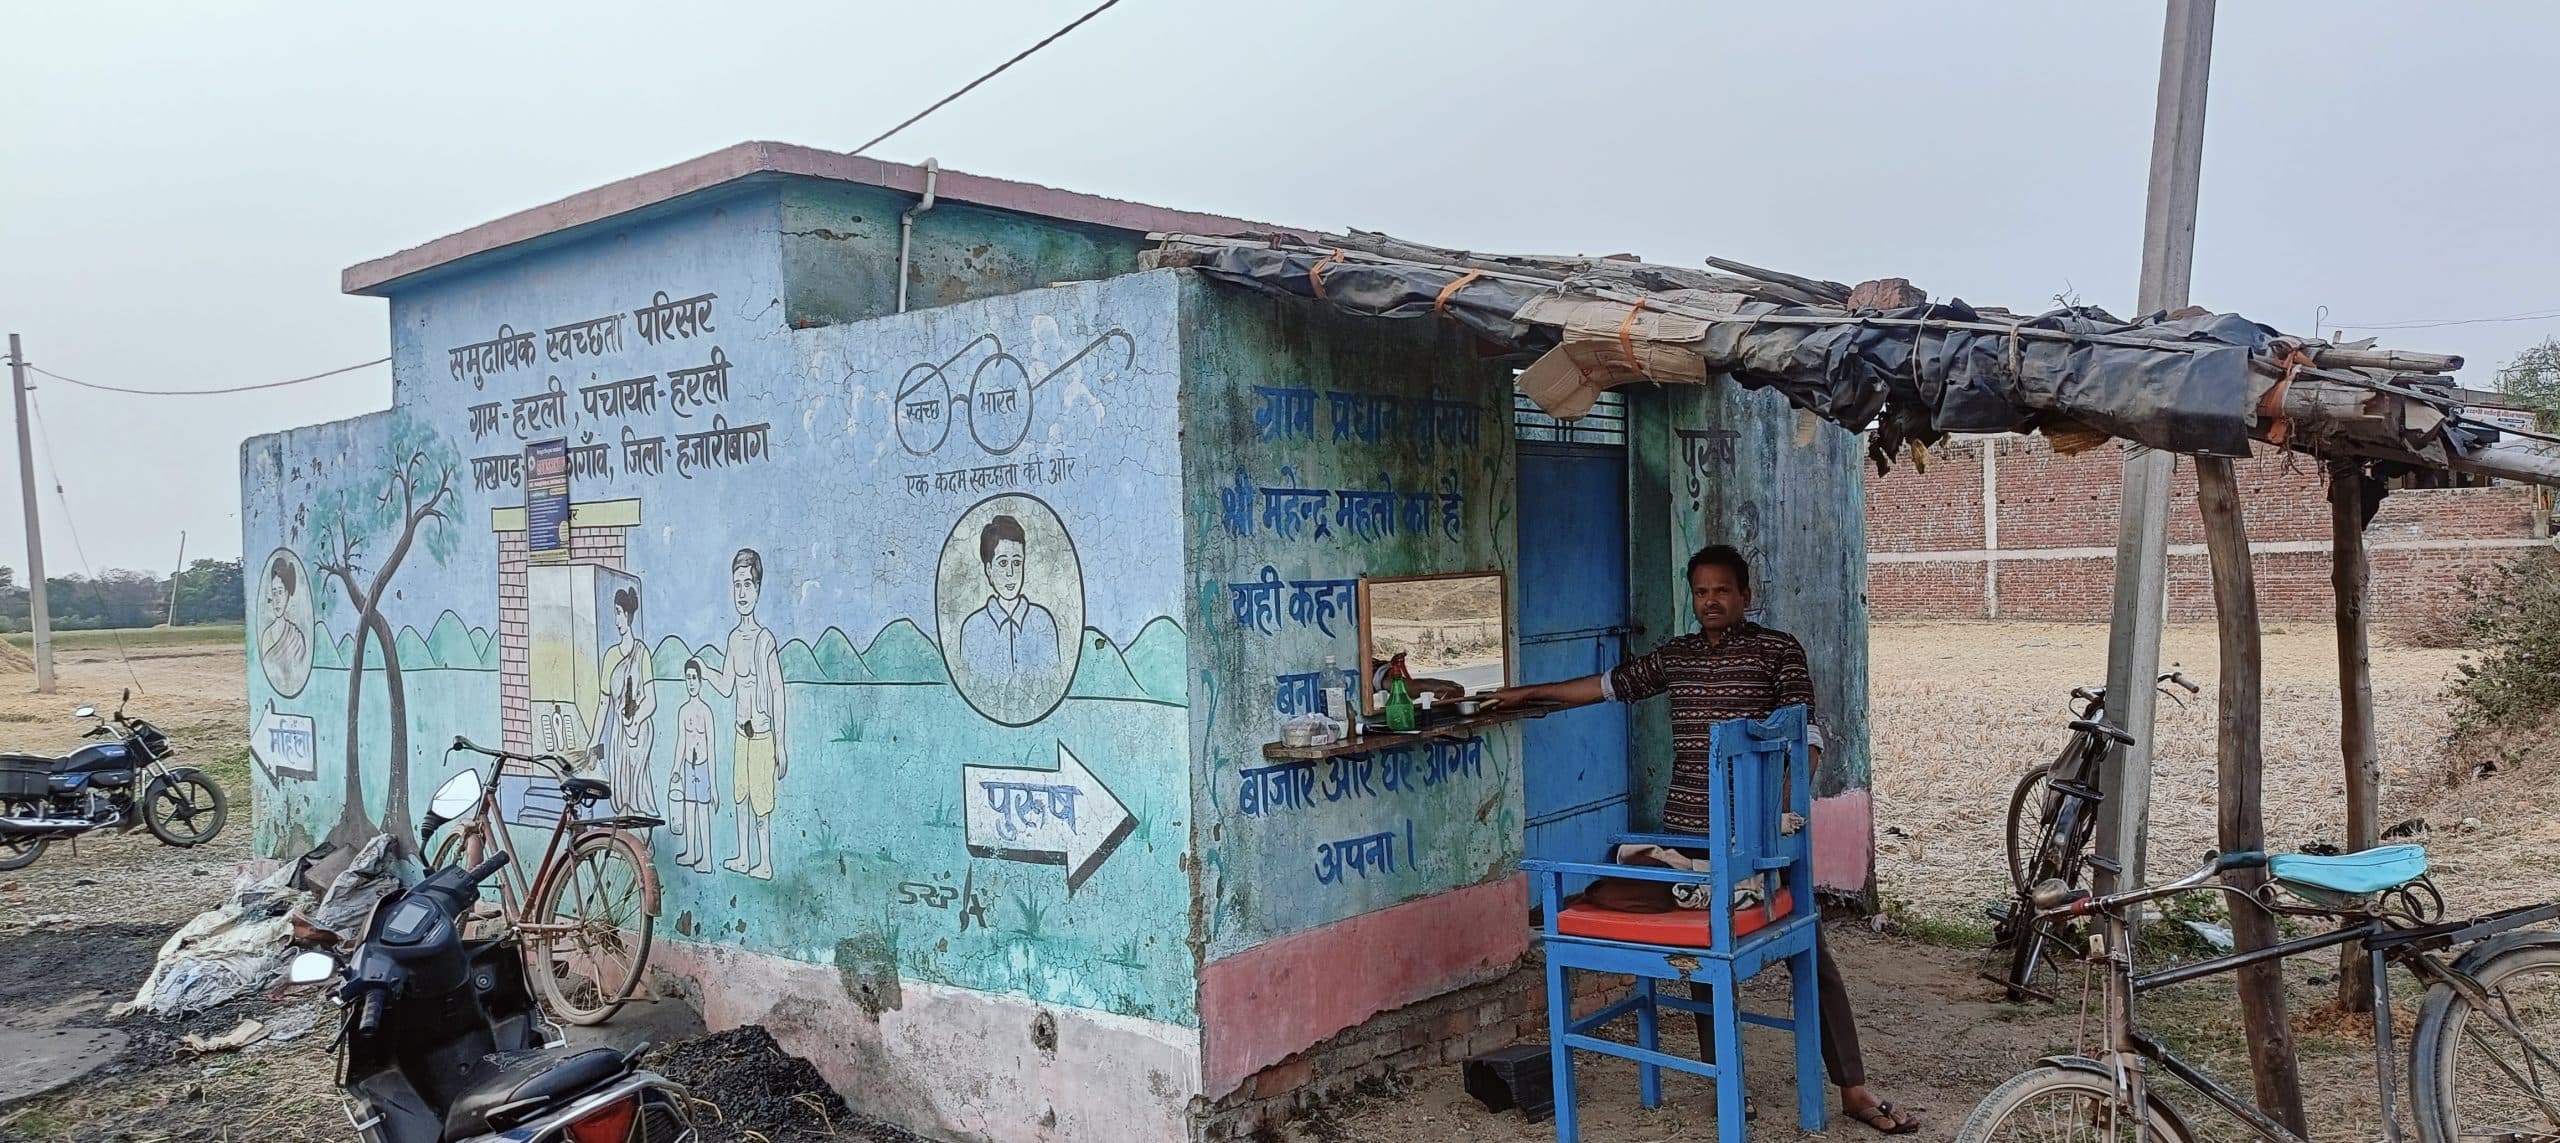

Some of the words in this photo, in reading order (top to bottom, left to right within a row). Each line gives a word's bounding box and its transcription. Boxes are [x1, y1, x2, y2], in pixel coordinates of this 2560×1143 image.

[448, 323, 536, 391] समुदायिक
[545, 313, 627, 363] स्वच्छता
[634, 290, 718, 345] परिसर
[905, 399, 940, 424] स्वच्छ
[979, 389, 1017, 415] भारत
[1253, 385, 1320, 444] ग्राम
[905, 474, 928, 497] एक
[935, 469, 968, 495] कदम
[970, 462, 1018, 493] स्वच्छता
[1023, 452, 1044, 485] की
[1048, 449, 1076, 485] ओर
[1221, 465, 1256, 537] श्री
[1259, 465, 1332, 543] महेन्द्र
[1335, 472, 1399, 543] महतो
[1402, 490, 1435, 538] का
[1438, 467, 1464, 544] है
[1229, 565, 1285, 637] यही
[1239, 761, 1317, 818] बाजार
